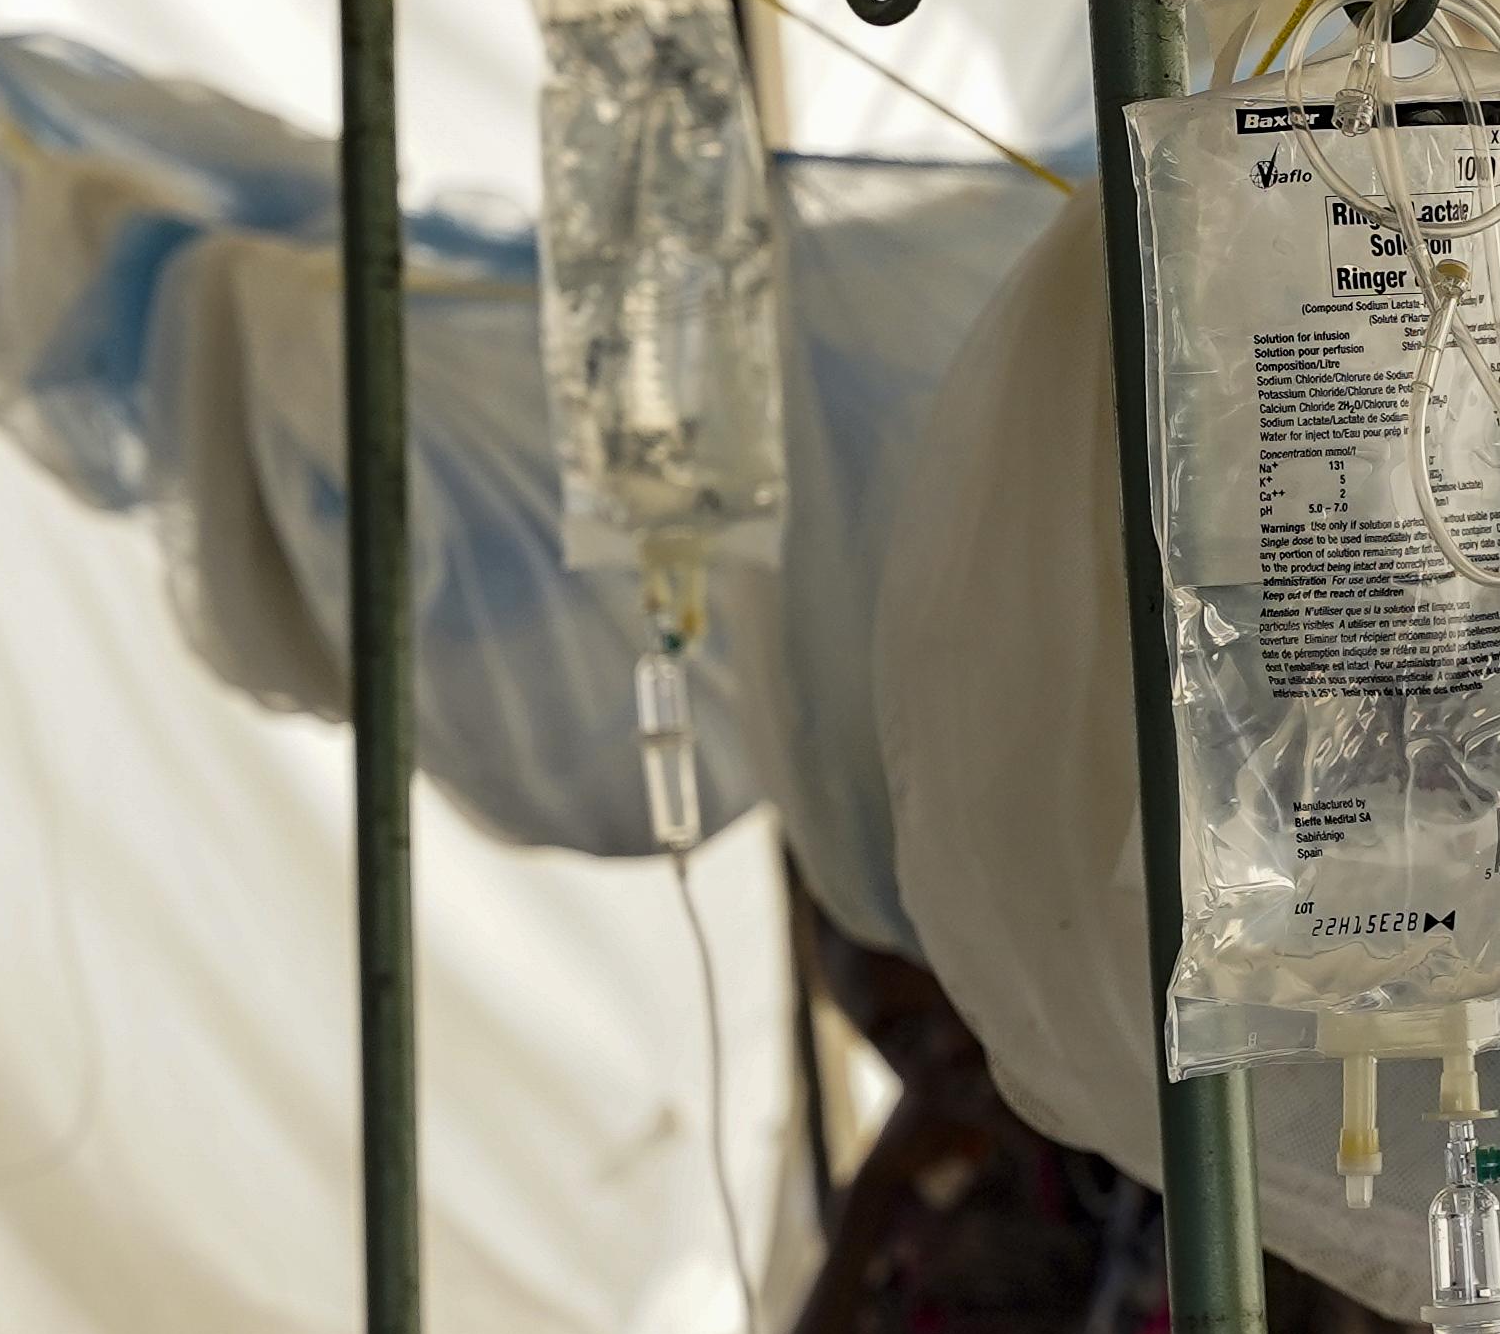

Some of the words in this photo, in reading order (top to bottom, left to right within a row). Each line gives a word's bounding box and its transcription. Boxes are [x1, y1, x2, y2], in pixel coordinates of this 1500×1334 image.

[1457, 156, 1496, 181] 100
[1332, 202, 1396, 230] Rin
[1371, 234, 1452, 257] Solon
[1336, 267, 1407, 295] Ringer
[1302, 302, 1353, 315] (Compound
[1356, 301, 1388, 311] Sodium
[1254, 333, 1294, 345] Solution
[1297, 332, 1310, 342] for
[1255, 348, 1295, 359] Solution
[1299, 347, 1320, 358] pour
[1323, 344, 1364, 357] perfusion
[1256, 360, 1340, 373] Composition/Litre
[1257, 376, 1292, 387] Sodium
[1296, 372, 1371, 384] Chloride/Chlorure
[1374, 370, 1383, 379] de
[1258, 389, 1306, 400] Potassium
[1309, 386, 1383, 398] Chloride/Chlorure
[1386, 385, 1396, 394] de
[1260, 403, 1296, 414] Calcium
[1299, 401, 1335, 412] Chloride
[1400, 398, 1409, 407] de
[1260, 417, 1295, 428] Sodium
[1297, 414, 1365, 426] Lactate/Lactate
[1367, 413, 1378, 423] de
[1260, 431, 1287, 442] Water
[1290, 430, 1302, 441] for
[1363, 428, 1382, 439] pour
[1260, 448, 1322, 460] Concentration
[1329, 461, 1345, 471] 131
[1260, 506, 1273, 517] pH
[1309, 503, 1323, 514] 5.0
[1334, 502, 1348, 512] 7.0
[1260, 523, 1306, 535] Warnings
[1311, 521, 1326, 531] Use
[1329, 520, 1348, 532] only
[1360, 520, 1392, 530] solution
[1260, 537, 1289, 548] Single
[1292, 535, 1313, 546] dose
[1316, 535, 1326, 544] to
[1327, 534, 1338, 544] be
[1340, 534, 1361, 544] used
[1260, 551, 1276, 561] any
[1280, 549, 1313, 560] portion
[1315, 548, 1325, 558] of
[1327, 548, 1360, 558] solution
[1363, 546, 1403, 558] remaining
[1261, 563, 1271, 573] to
[1274, 563, 1288, 573] the
[1291, 562, 1325, 574] product
[1327, 561, 1351, 573] being
[1353, 561, 1377, 571] intact
[1379, 560, 1394, 570] and
[1263, 575, 1327, 587] administration
[1332, 575, 1346, 585] For
[1348, 576, 1364, 585] use
[1366, 575, 1391, 585] under
[1263, 590, 1285, 602] Keep
[1287, 591, 1302, 600] out
[1302, 589, 1312, 599] of
[1314, 589, 1327, 599] the
[1330, 588, 1355, 598] reach
[1357, 588, 1367, 598] of
[1368, 587, 1404, 597] children
[1260, 607, 1300, 618] Attention
[1305, 606, 1343, 617] N'utiliser
[1345, 607, 1362, 618] que
[1383, 604, 1415, 614] solution
[1259, 621, 1300, 634] particules
[1303, 620, 1334, 631] visibles
[1347, 619, 1376, 628] utiliser
[1379, 619, 1389, 628] en
[1392, 619, 1406, 628] une
[1260, 635, 1299, 646] ouverture
[1341, 633, 1357, 643] tout
[1359, 631, 1396, 644] récipient
[1262, 649, 1279, 659] date
[1294, 647, 1340, 660] péremption
[1342, 645, 1378, 658] indiquée
[1347, 660, 1369, 670] intact
[1374, 660, 1394, 670] Pour
[1396, 654, 1454, 668] administration
[1471, 653, 1489, 664] voie
[1268, 676, 1286, 685] Pour
[1328, 676, 1347, 685] sous
[1363, 687, 1382, 696] hors
[1433, 684, 1448, 695] des
[1450, 681, 1483, 693] enfants
[1293, 799, 1353, 812] Manufactured
[1356, 798, 1366, 809] by
[1295, 816, 1322, 828] Bieffe
[1324, 813, 1357, 825] Medital
[1359, 812, 1372, 822] SA
[1297, 847, 1323, 860] Spain
[1294, 902, 1315, 914] LOT
